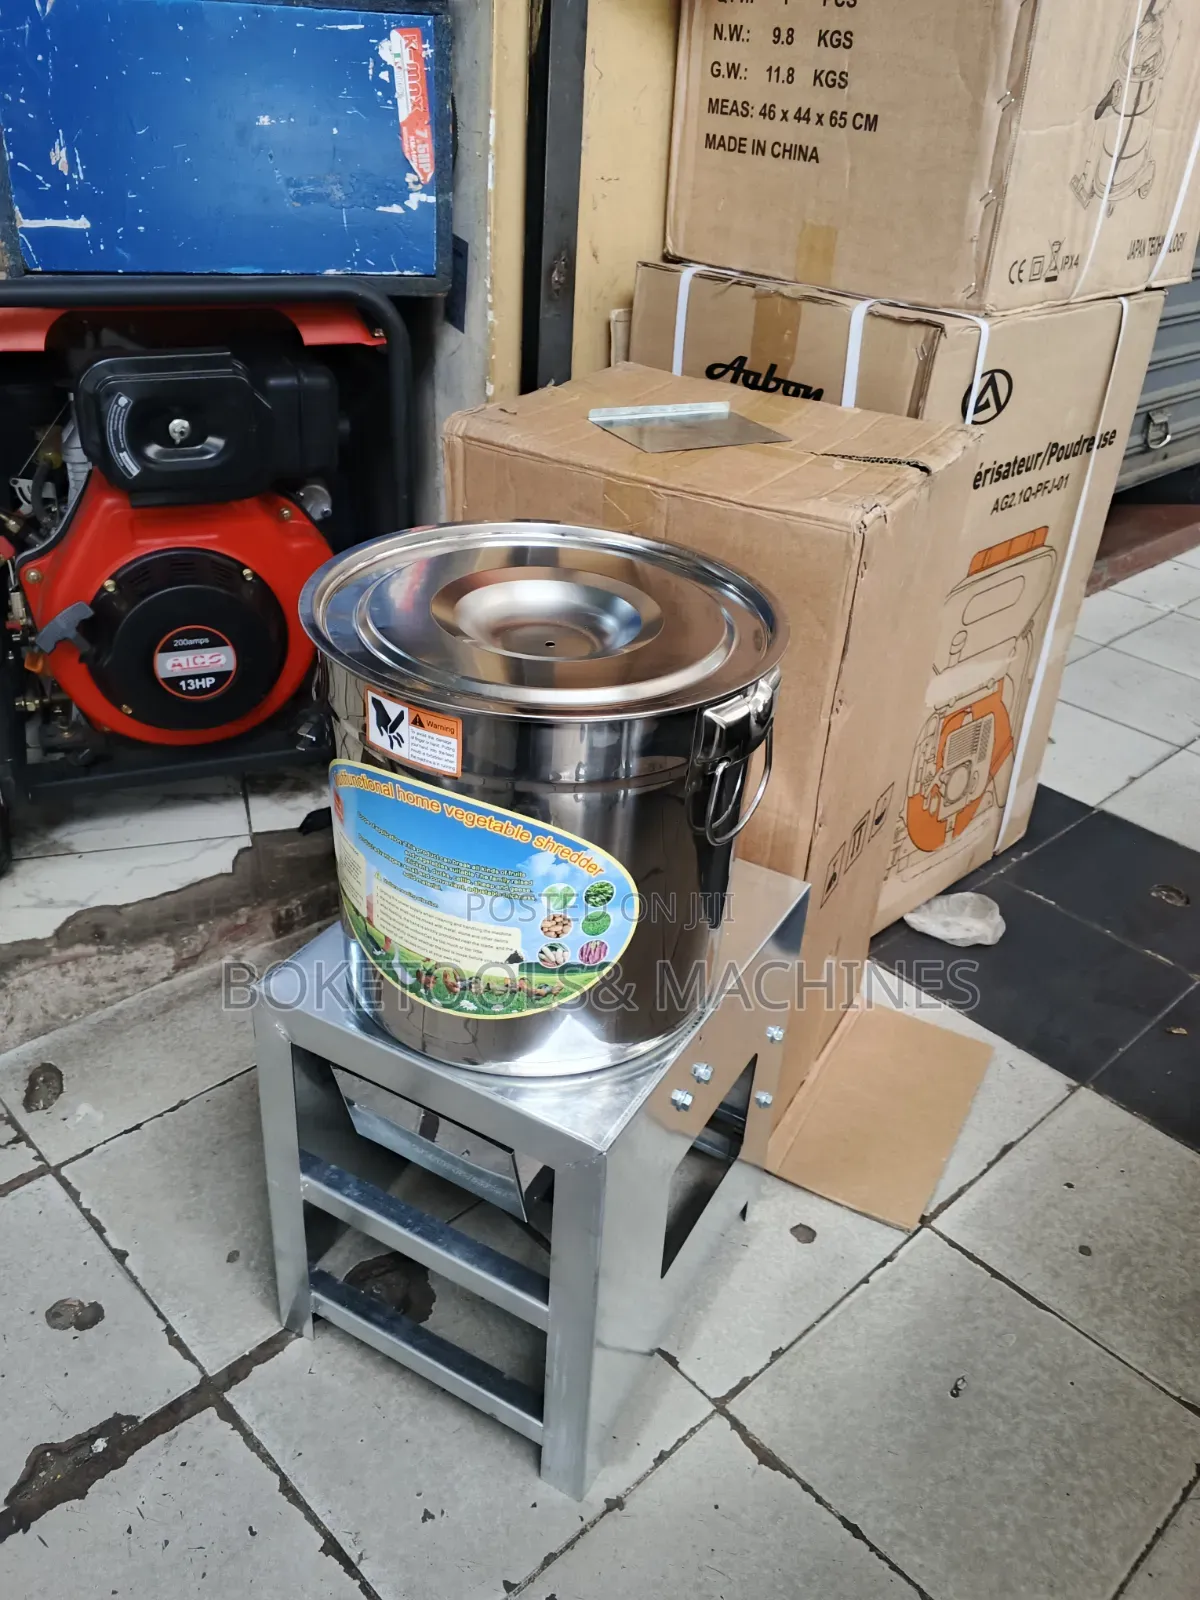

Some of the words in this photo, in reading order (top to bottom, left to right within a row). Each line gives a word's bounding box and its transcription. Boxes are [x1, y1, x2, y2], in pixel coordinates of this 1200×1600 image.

[713, 23, 750, 43] N.W.:
[772, 26, 795, 46] 9.8
[817, 29, 853, 49] KGS
[710, 60, 748, 80] G.W.:
[766, 65, 795, 85] 11.8
[812, 69, 849, 89] KGS
[707, 97, 754, 118] MEAS:
[758, 103, 776, 121] 46
[780, 109, 789, 123] x
[793, 107, 811, 125] 44
[815, 112, 825, 126] x
[829, 110, 848, 129] 65
[852, 112, 879, 132] CM
[704, 133, 747, 155] MADE
[751, 138, 767, 157] IN
[770, 141, 820, 164] CHINA
[1148, 232, 1188, 257] TECHLOGY
[179, 677, 216, 691] 13HP
[426, 719, 455, 735] Warning
[395, 784, 442, 814] home
[443, 803, 533, 844] vegetable
[532, 834, 605, 878] shredder
